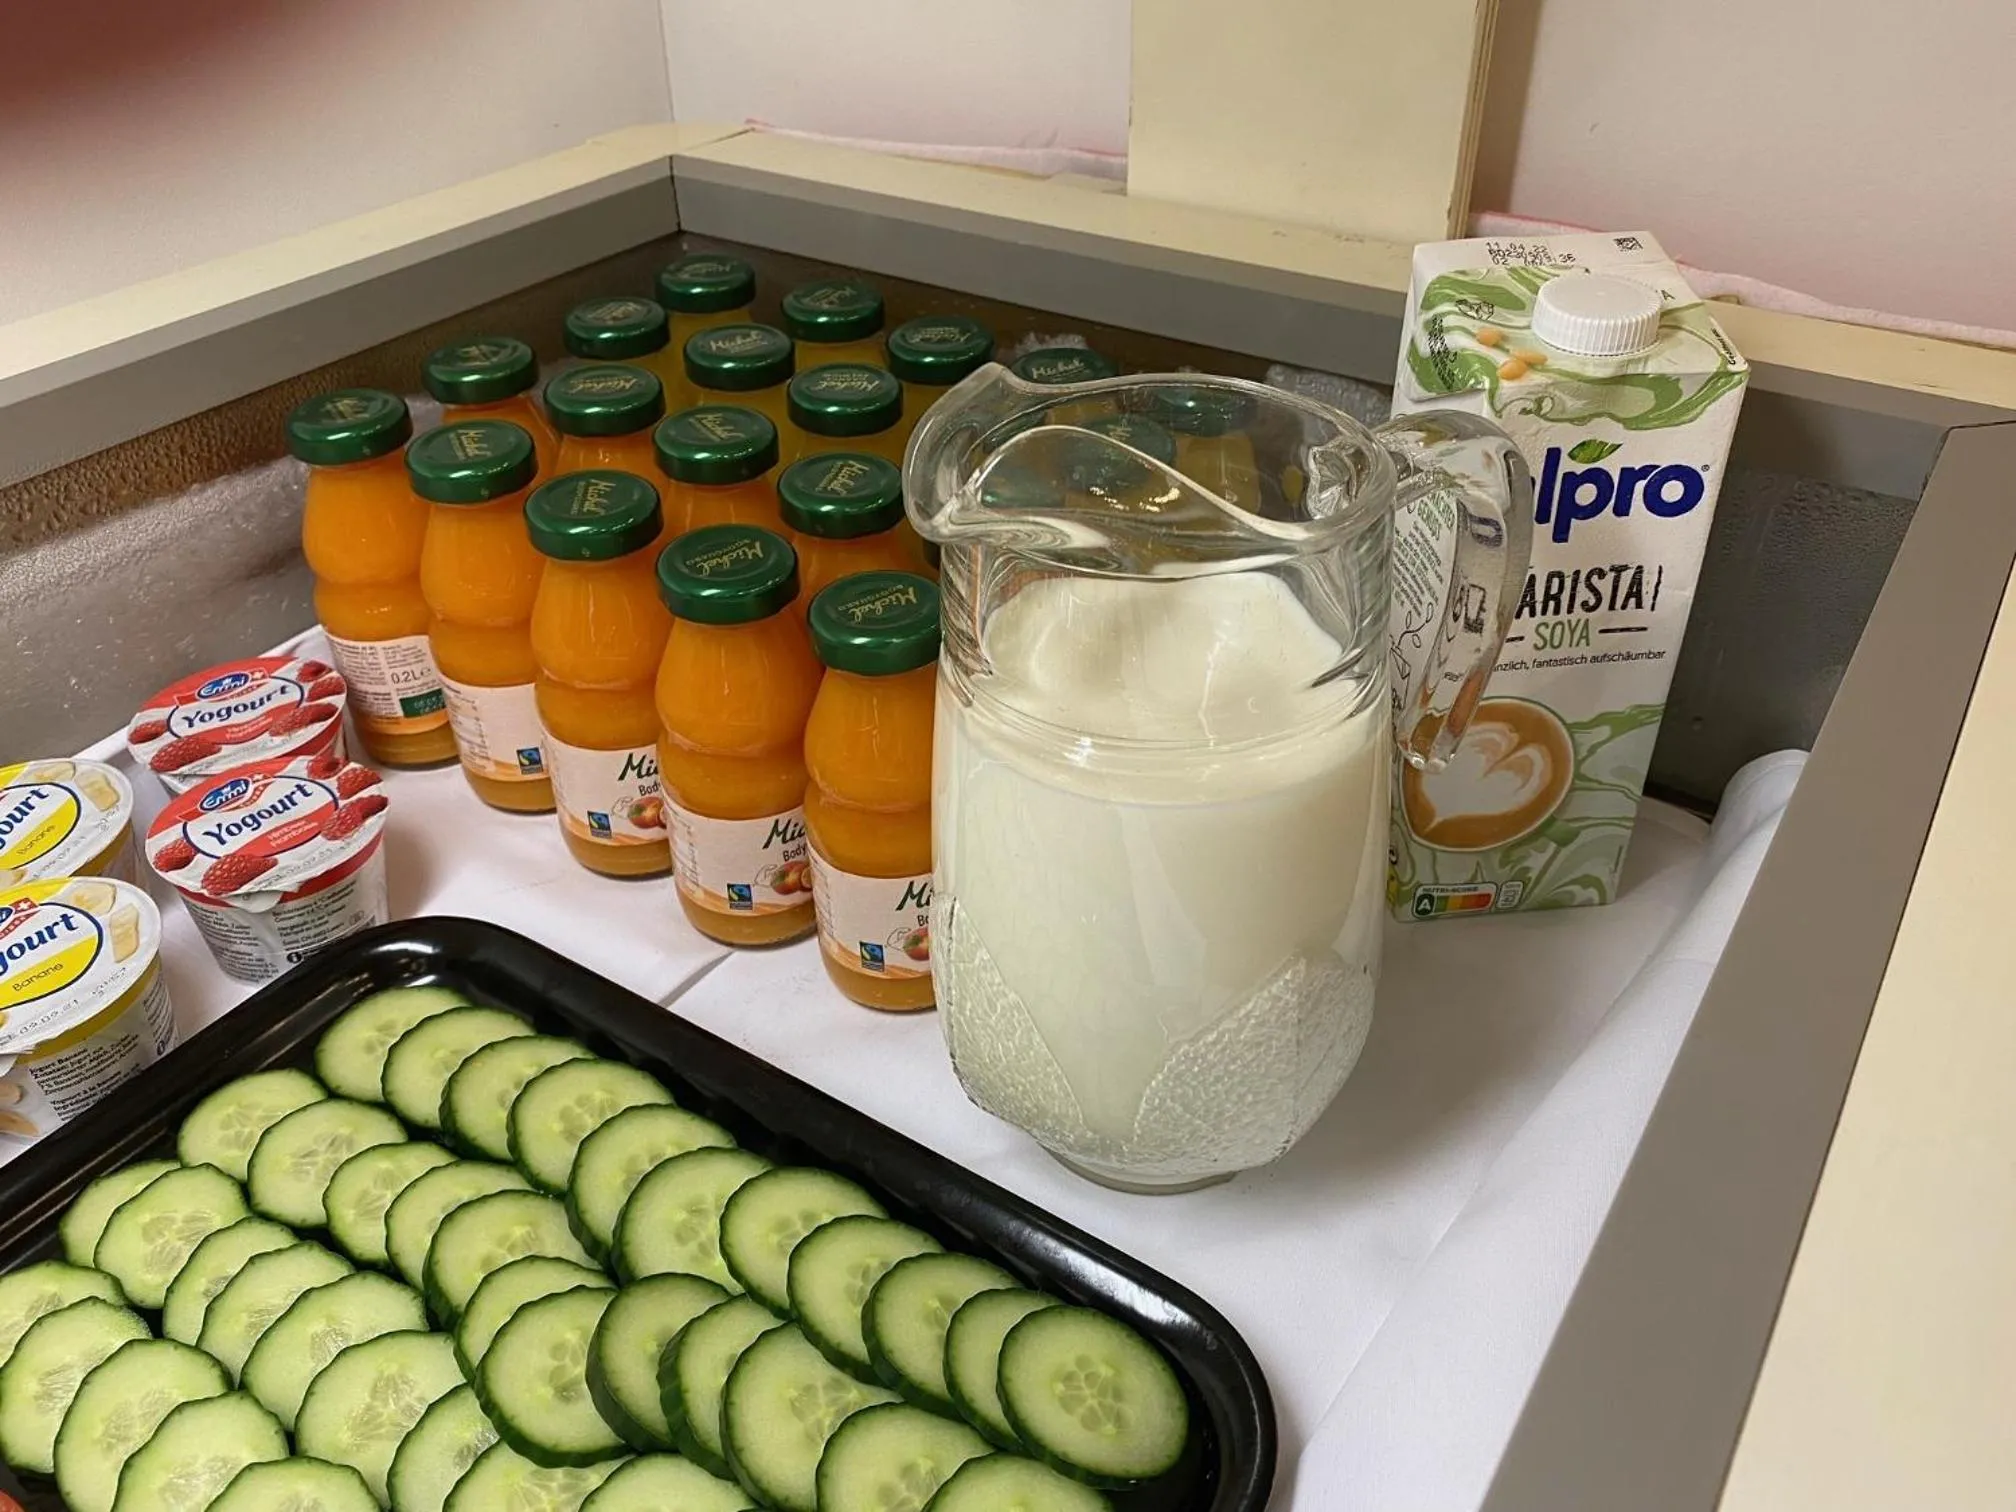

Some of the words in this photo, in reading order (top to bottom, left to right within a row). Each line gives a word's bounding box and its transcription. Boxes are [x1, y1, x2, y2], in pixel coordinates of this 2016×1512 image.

[1531, 446, 1705, 544] lpro
[696, 541, 763, 577] Michel
[848, 586, 918, 623] Michel
[1514, 564, 1646, 620] ARISTA
[1533, 618, 1591, 651] SOYA
[1532, 654, 1588, 669] fantastisch
[1590, 649, 1666, 665] aufschäumbar
[181, 684, 294, 729] Yogourt
[204, 780, 247, 809] Emmi
[638, 781, 661, 796] Bod
[202, 783, 314, 847] Yogourt
[1417, 898, 1432, 912] A
[12, 963, 64, 992] Banane
